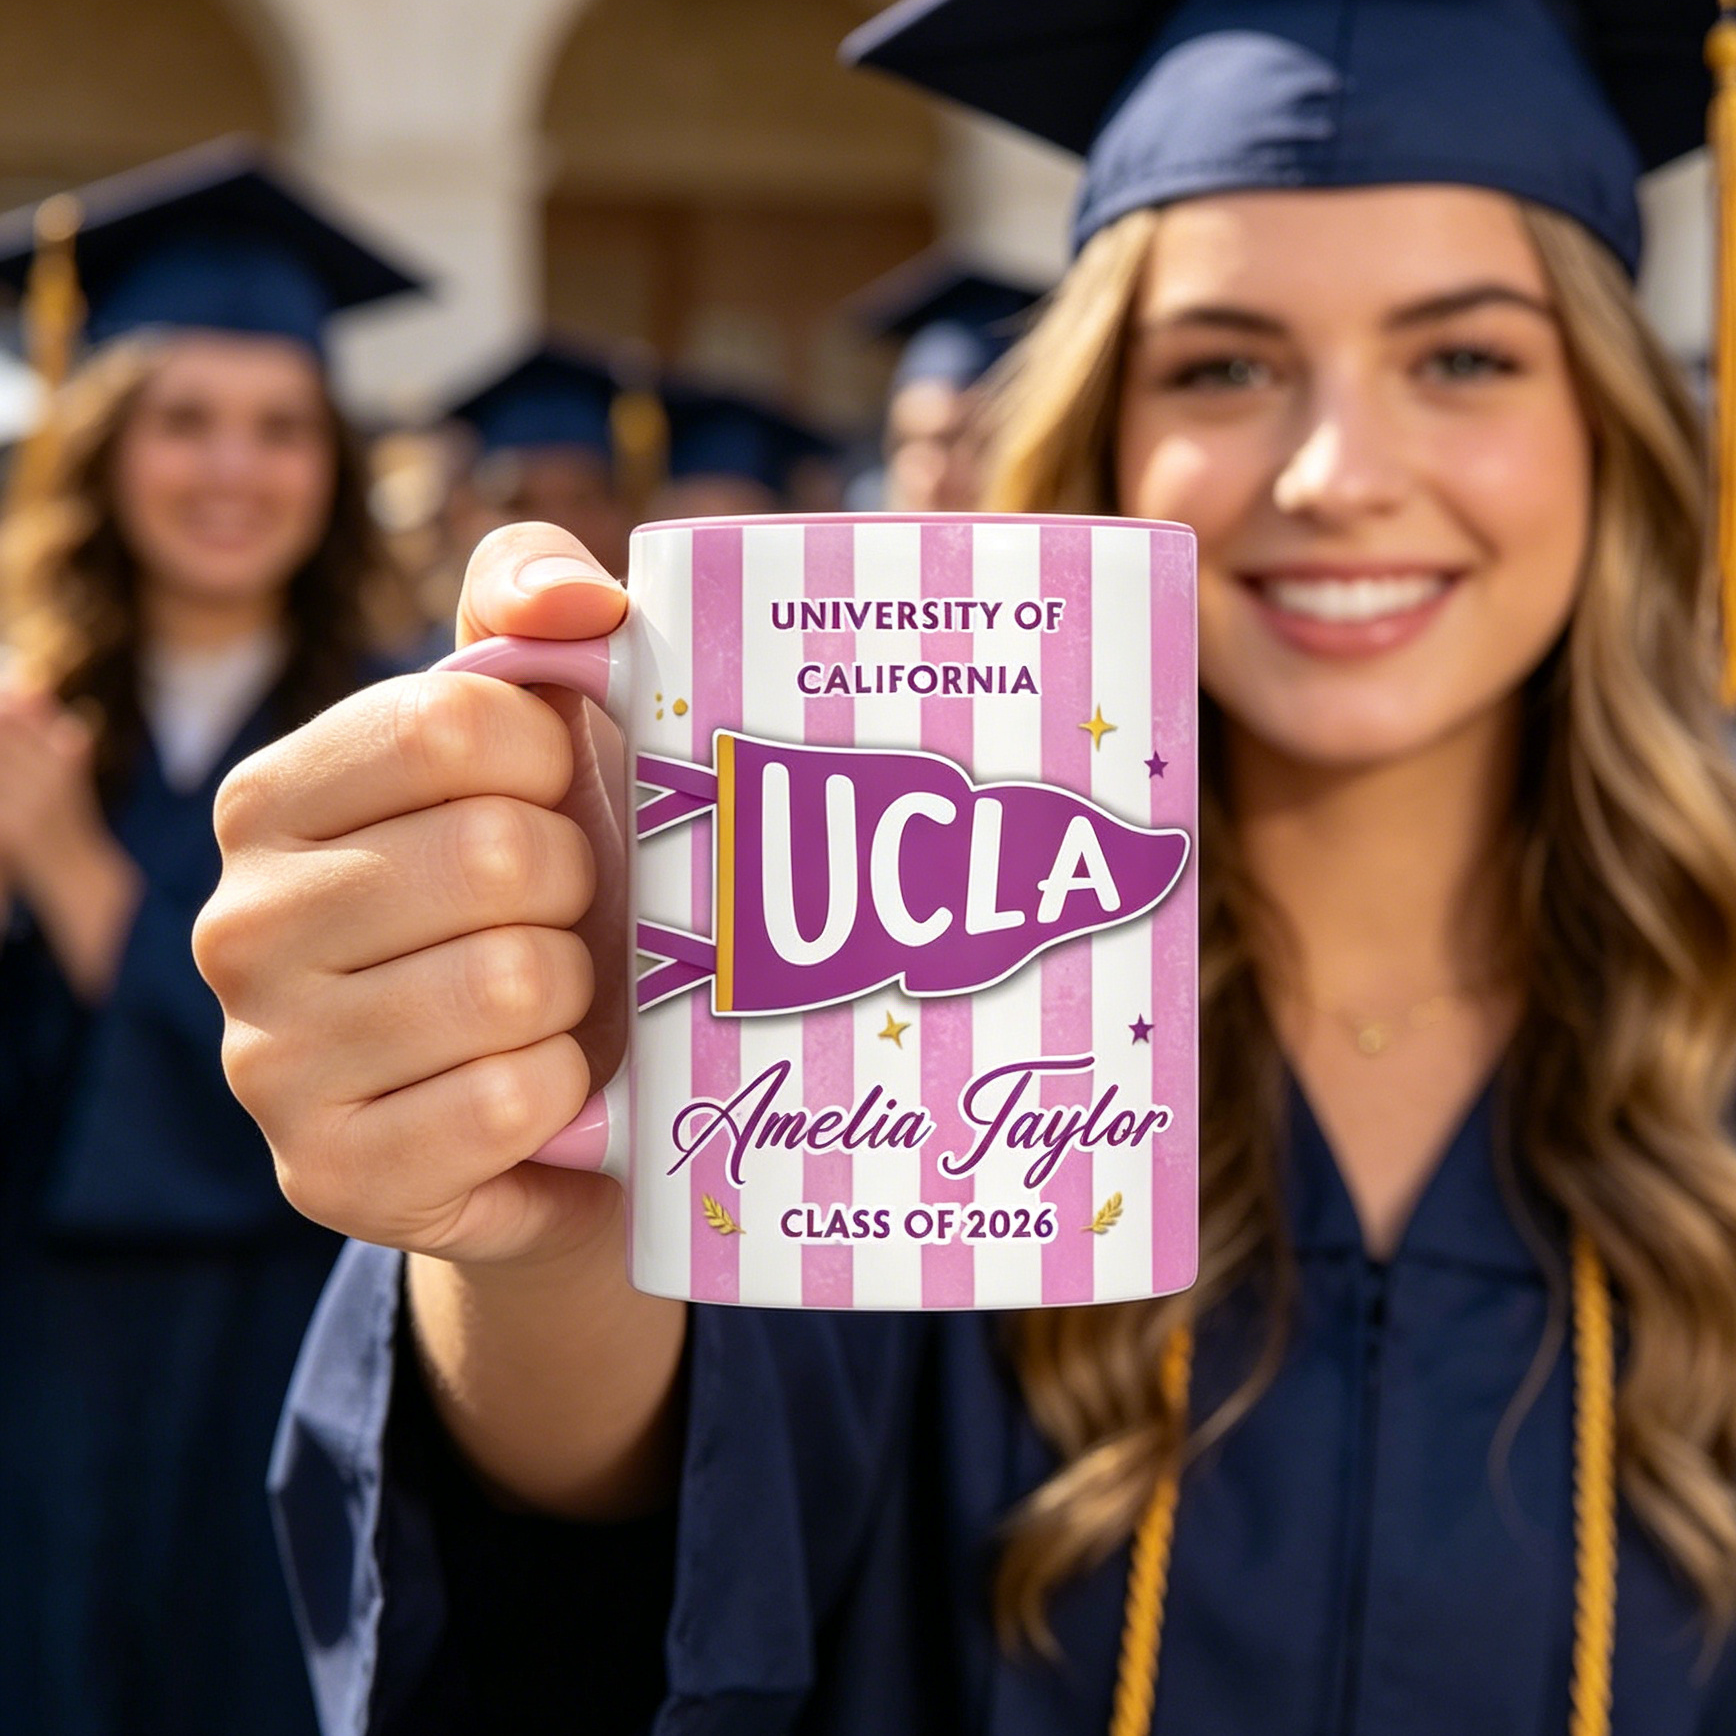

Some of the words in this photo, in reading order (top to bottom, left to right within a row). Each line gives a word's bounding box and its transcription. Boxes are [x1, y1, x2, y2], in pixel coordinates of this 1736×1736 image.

[771, 601, 1002, 631] UNIVERSITY
[1014, 601, 1064, 631] OF
[798, 664, 1040, 695] CALIFORNIA
[762, 762, 1121, 966] UCLA
[666, 1059, 932, 1185] Amelia
[942, 1056, 1170, 1189] Taylor
[780, 1208, 890, 1239] CLASS
[904, 1208, 954, 1239] OF
[966, 1208, 1054, 1239] 2026
